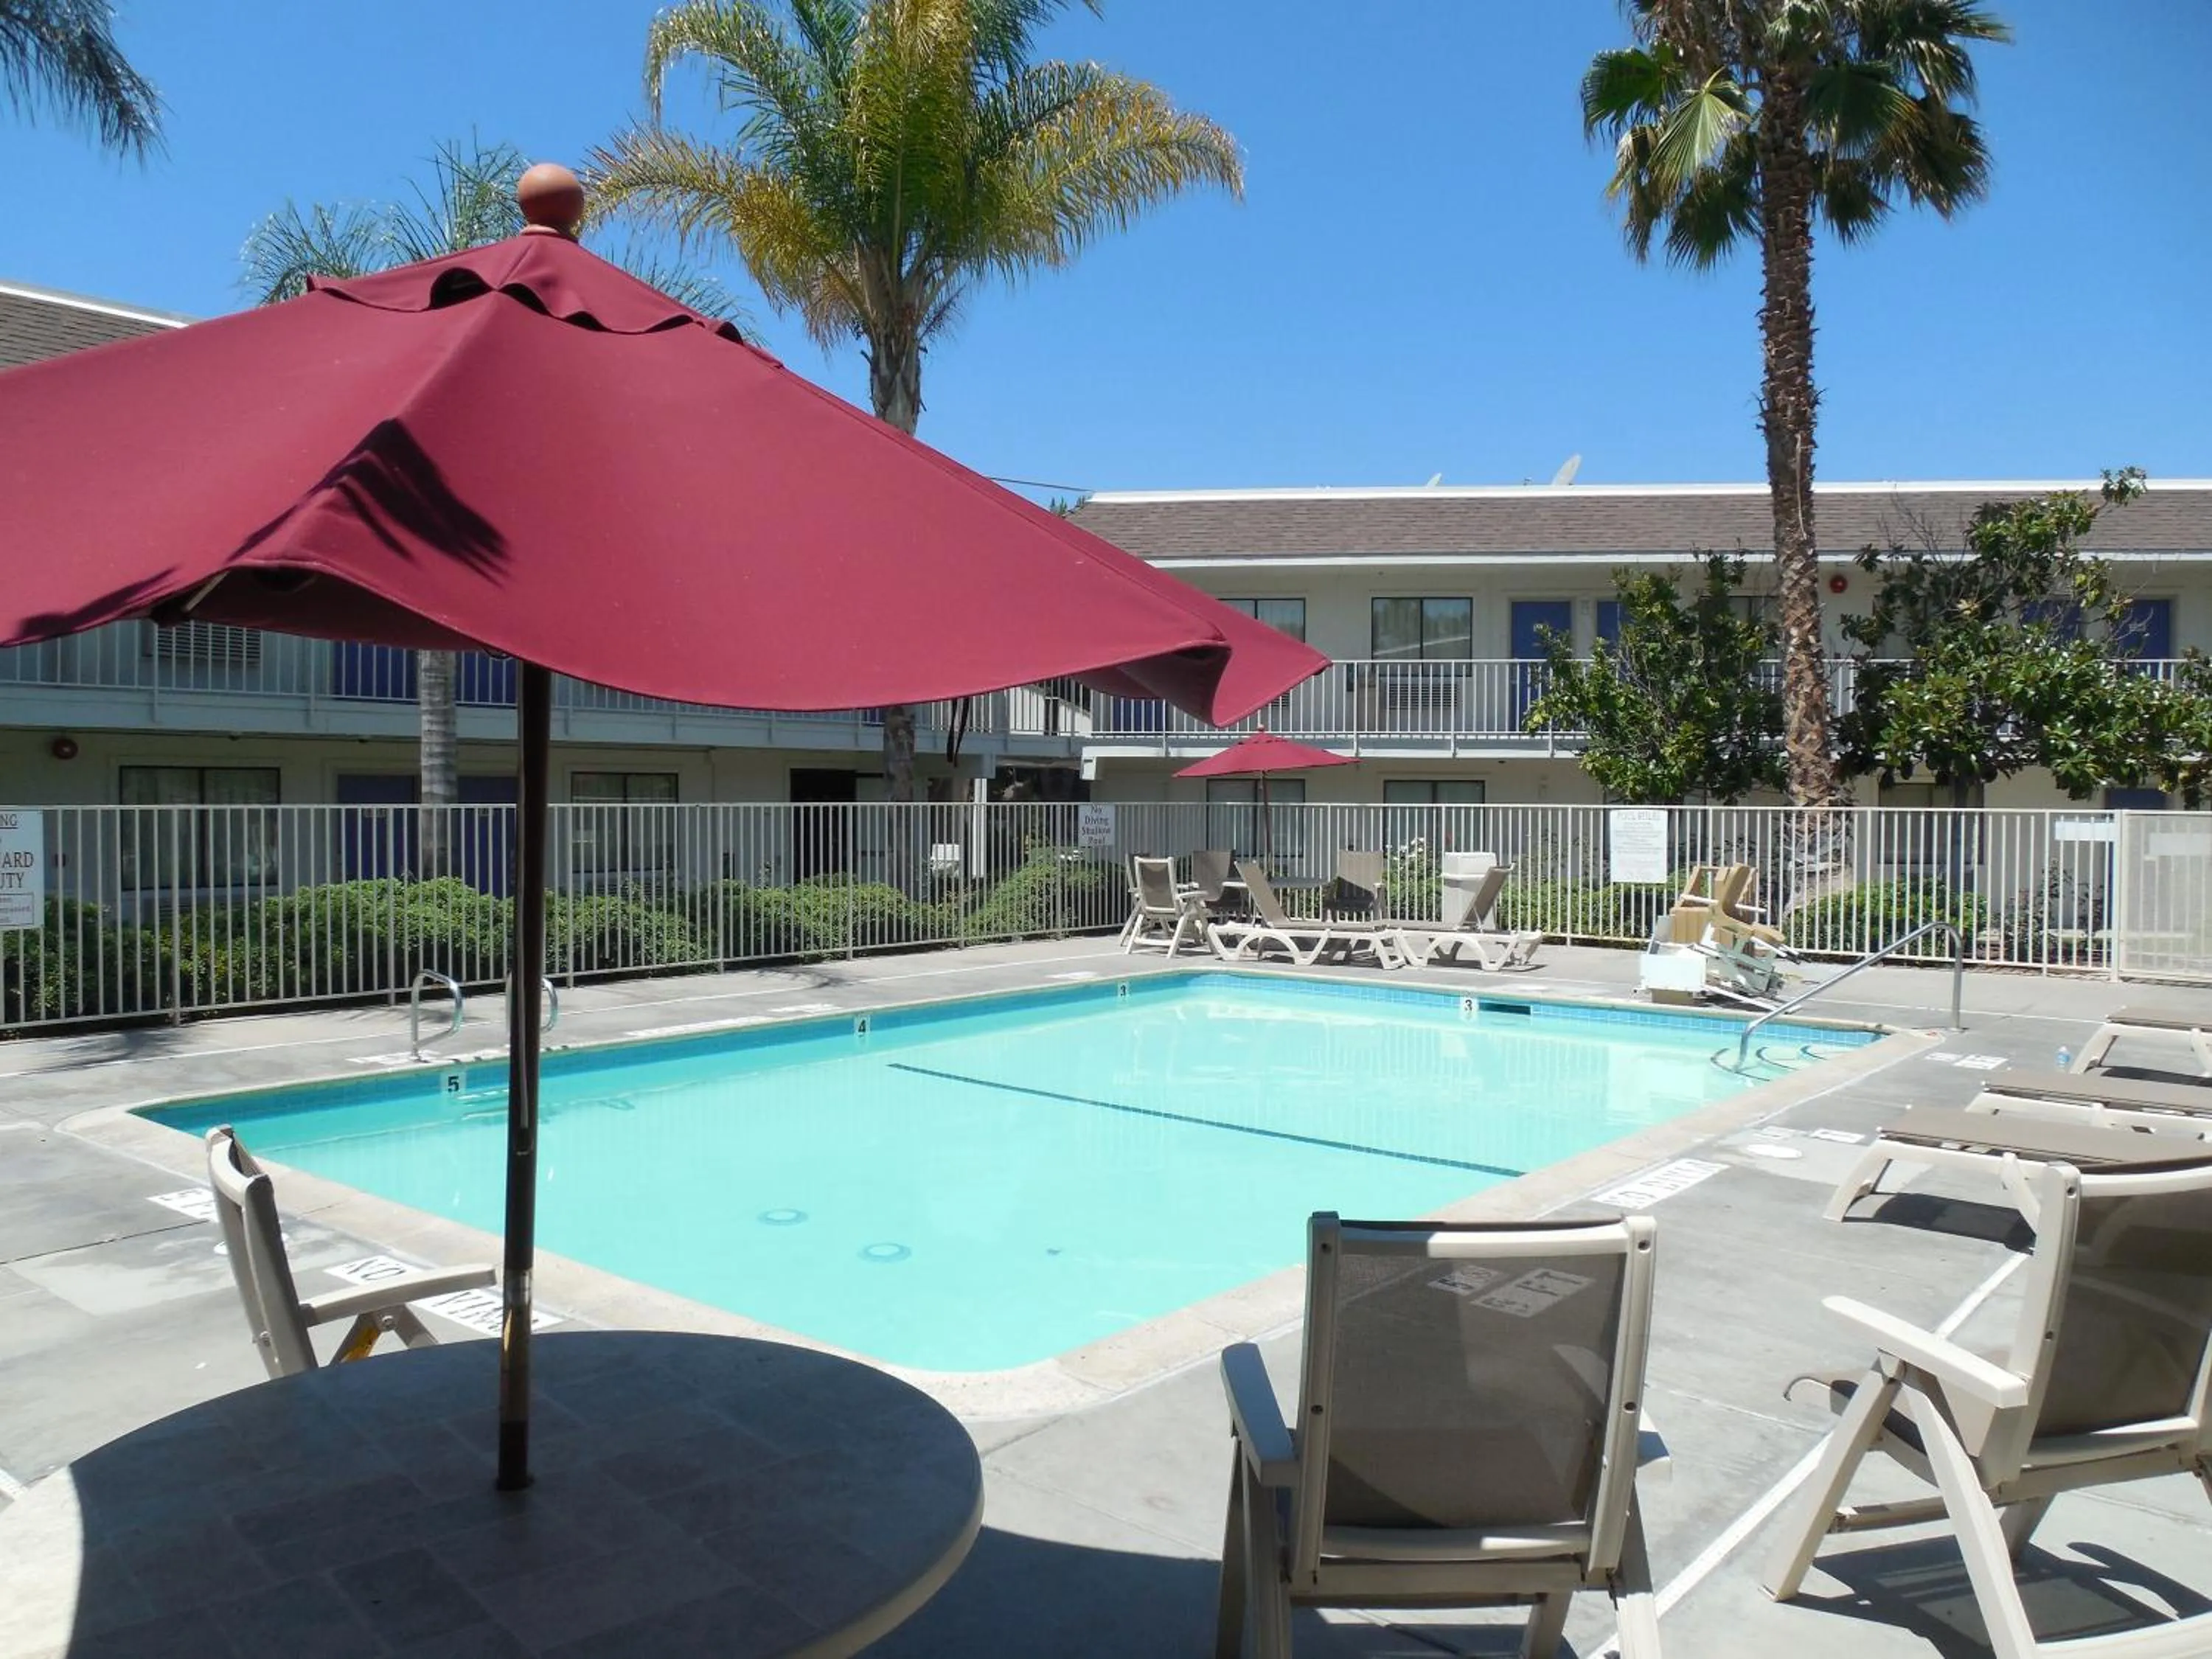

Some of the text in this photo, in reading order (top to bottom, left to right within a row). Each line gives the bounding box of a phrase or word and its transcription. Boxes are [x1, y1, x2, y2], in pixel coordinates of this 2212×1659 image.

[0, 852, 35, 868] ARD
[1120, 985, 1126, 996] 3
[1465, 999, 1472, 1011] 3
[858, 1020, 866, 1032] 4
[448, 1076, 459, 1092] 5
[346, 1258, 407, 1281] NO
